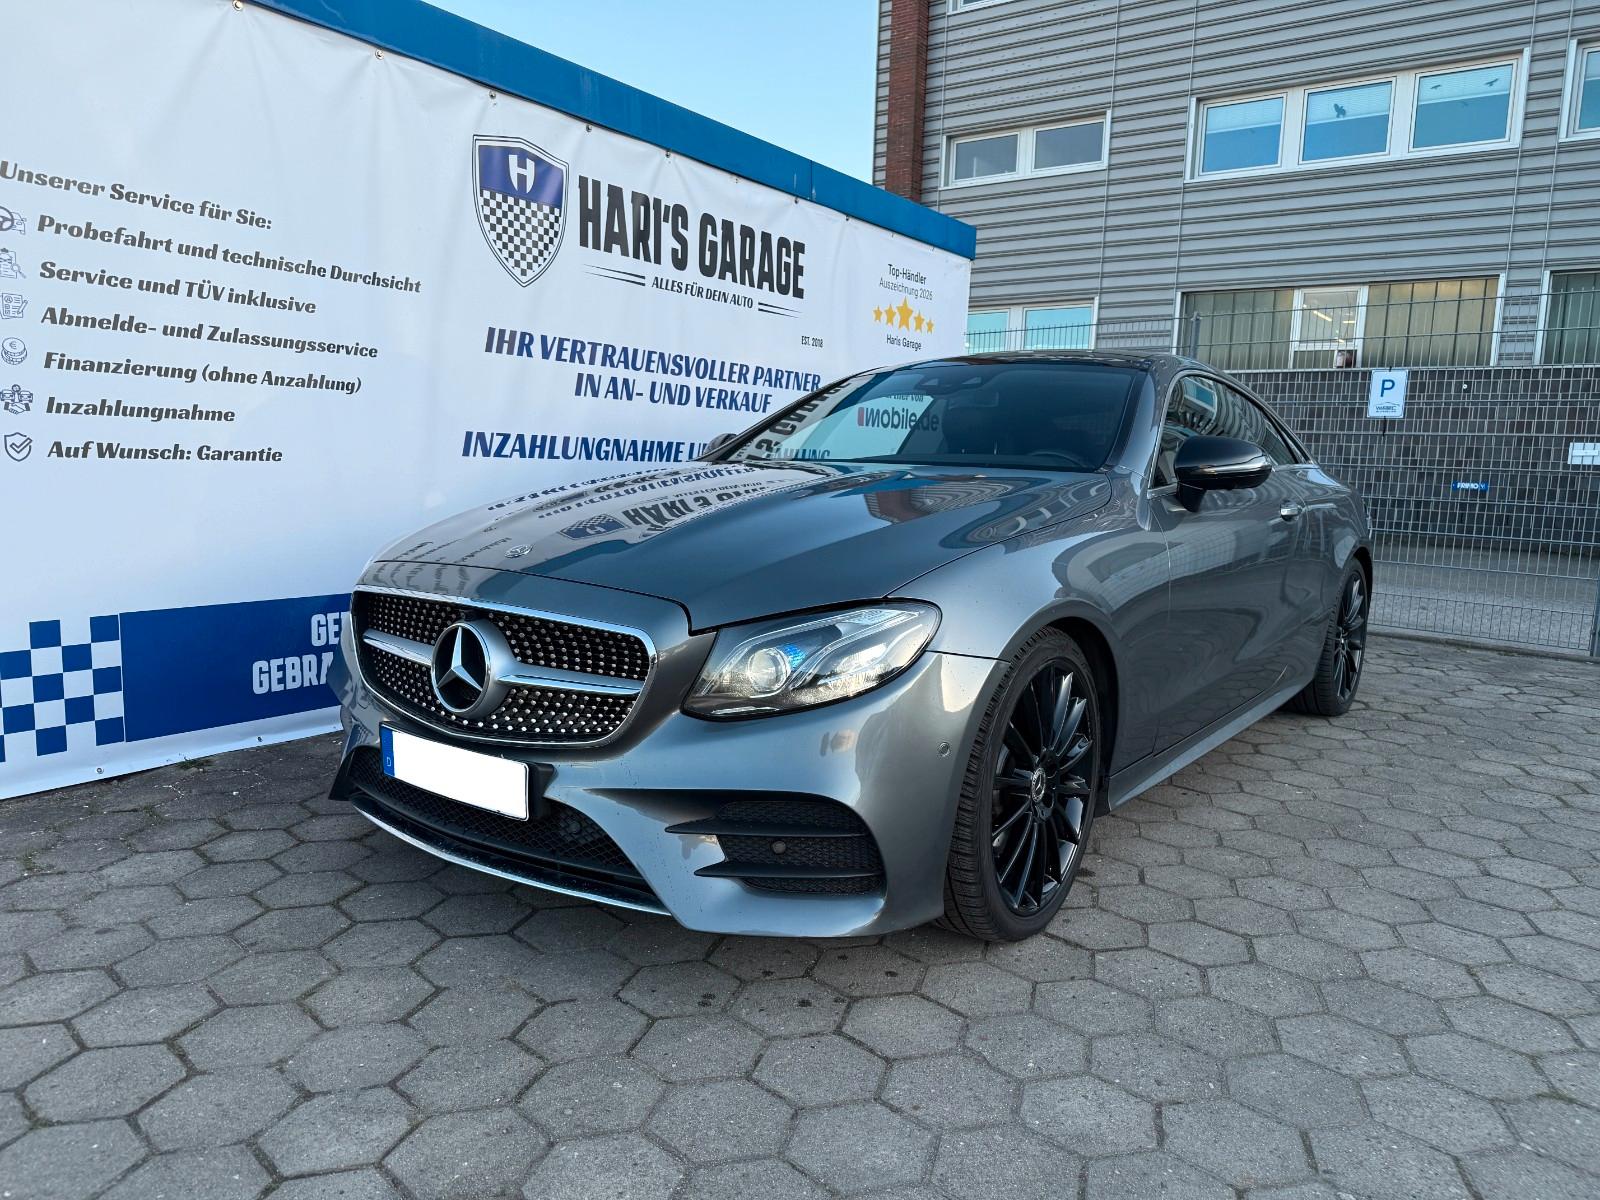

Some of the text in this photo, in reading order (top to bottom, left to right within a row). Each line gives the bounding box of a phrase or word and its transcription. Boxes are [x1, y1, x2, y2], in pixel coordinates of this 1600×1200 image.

[0, 160, 272, 230] Unserer Service für Sie:
[37, 214, 422, 293] Probefahrt und technische Durchsicht
[578, 175, 806, 300] HARI'S GARAGE
[39, 261, 317, 314] Service und TÜV inklusive
[651, 276, 754, 309] ALLES FÜR DEIN AUTO
[879, 277, 919, 299] Auszeichnung
[887, 263, 927, 286] Top-Händler
[40, 306, 378, 358] Abmelde- und Zulassungsservice
[902, 337, 922, 352] Garage
[43, 351, 362, 395] Finanzierung (ohne Anzahlung)
[484, 326, 821, 392] IHR VERTRAUENSVOLLER PARTNER
[574, 372, 774, 414] IN AN- UND VERKAUF
[1380, 379, 1396, 398] P
[45, 396, 236, 422] Inzahlungnahme
[47, 440, 283, 462] Auf Wunsch: Garantie
[461, 430, 686, 463] INZAHLUNGNAHME
